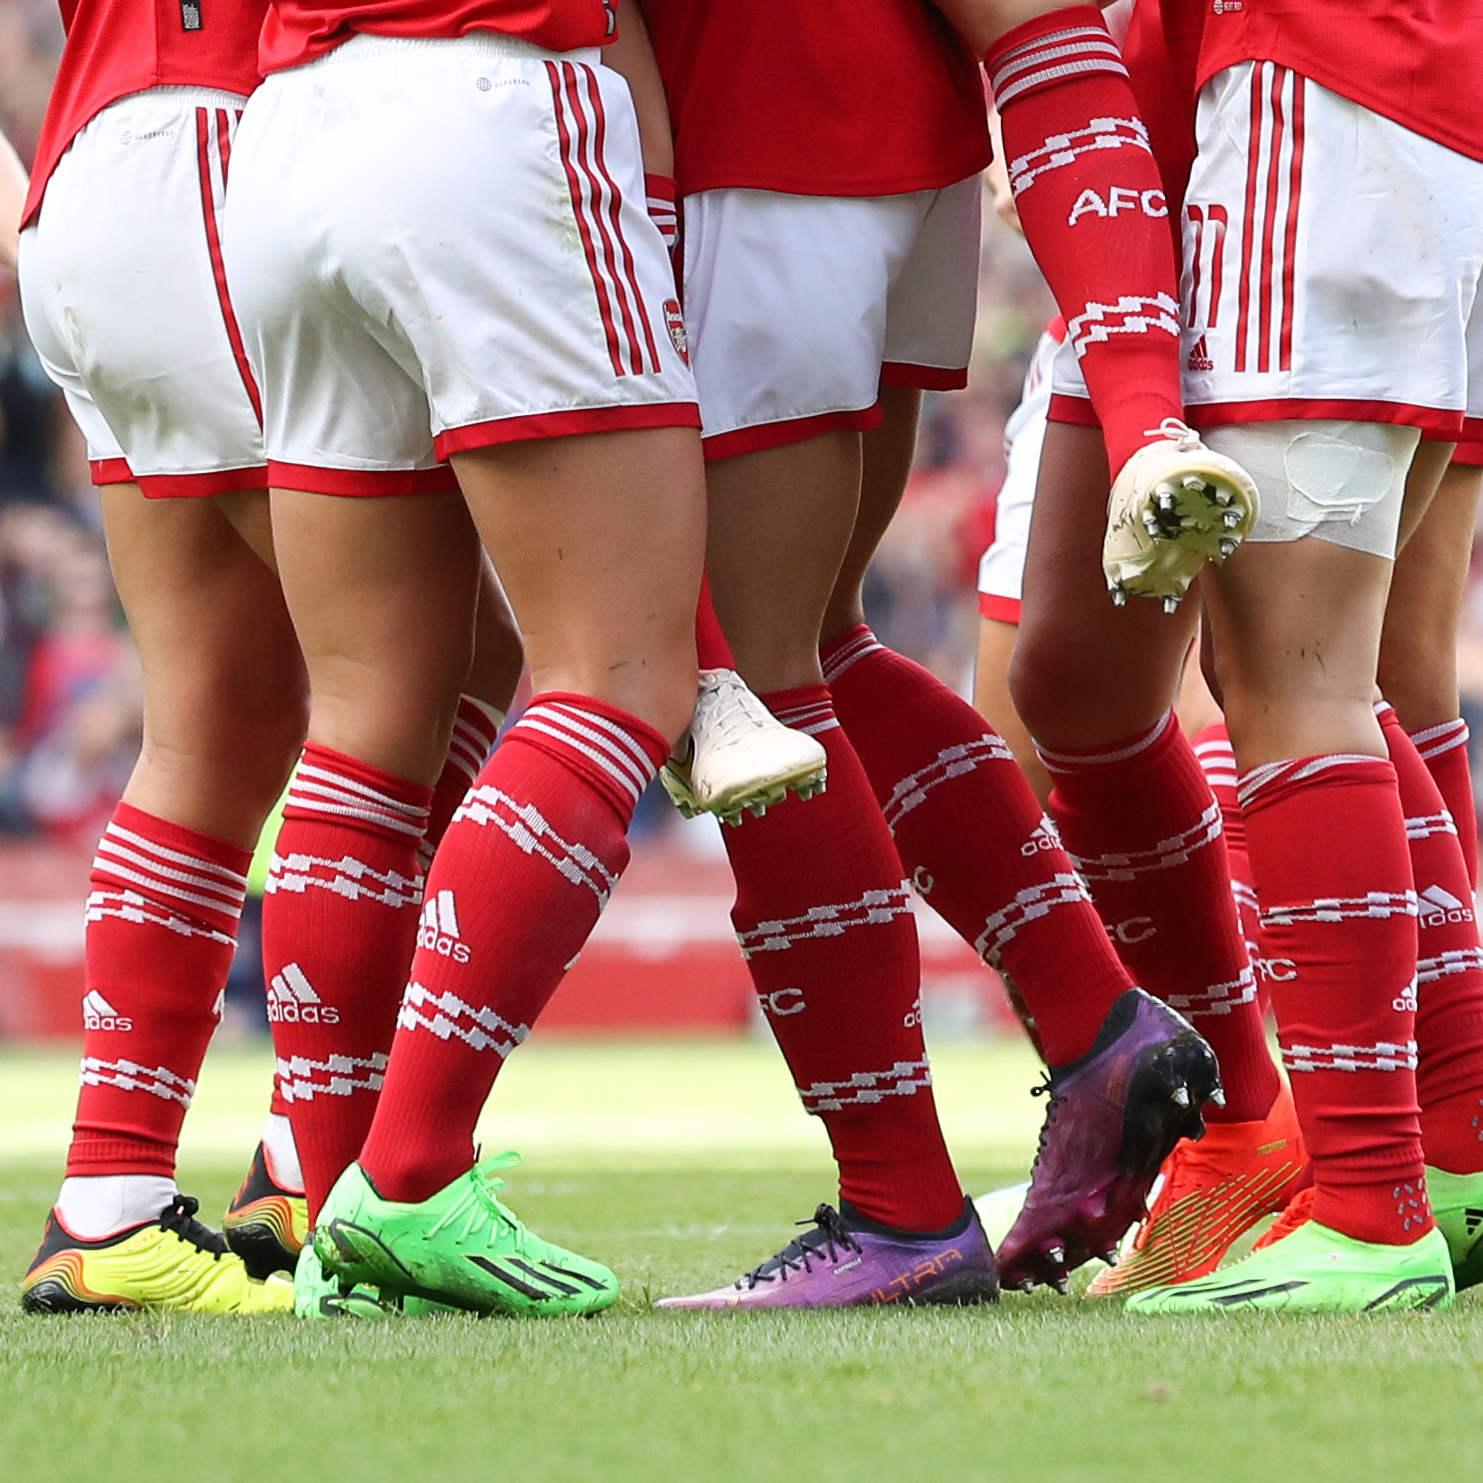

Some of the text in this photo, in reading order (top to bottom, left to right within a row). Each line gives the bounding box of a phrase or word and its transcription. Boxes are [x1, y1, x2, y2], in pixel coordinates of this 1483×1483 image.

[1069, 185, 1169, 226] AFC
[1186, 204, 1229, 329] 11
[871, 1248, 964, 1303] LTRA
